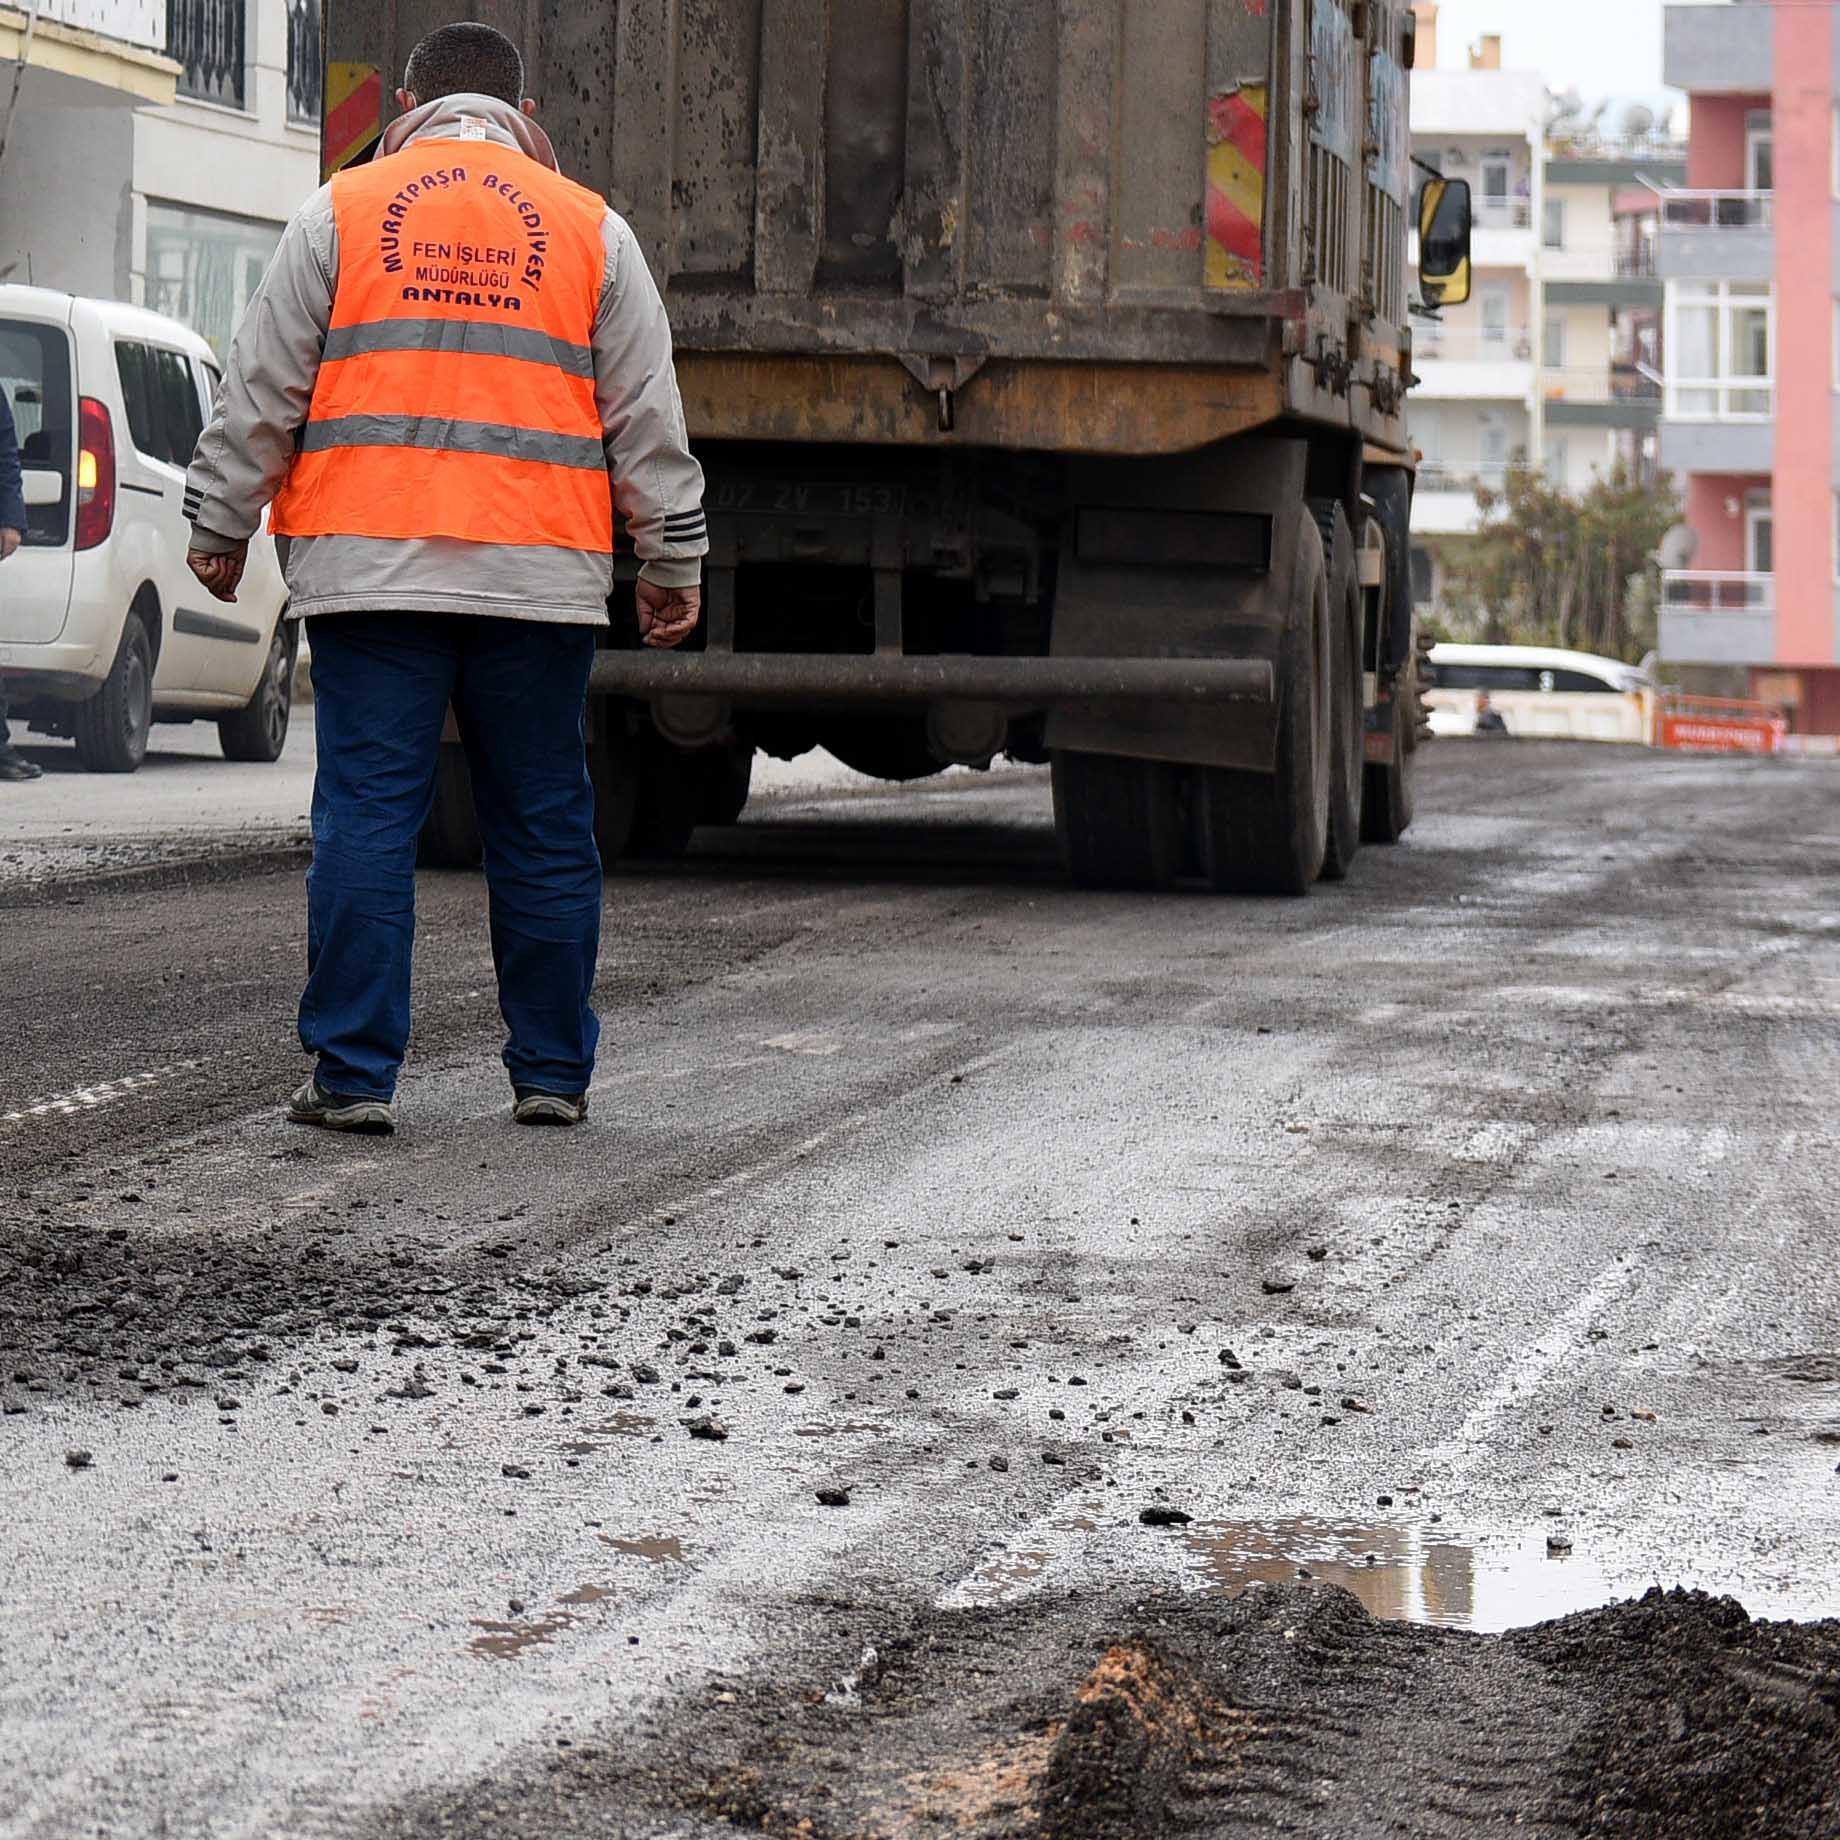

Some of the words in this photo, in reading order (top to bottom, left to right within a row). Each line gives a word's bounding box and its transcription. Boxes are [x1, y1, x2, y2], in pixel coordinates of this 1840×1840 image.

[380, 167, 466, 273] MURATPAŞA
[482, 174, 550, 292] BELEDİYESİ
[412, 242, 452, 260] FEN
[456, 241, 516, 266] İŞLERİ
[415, 264, 510, 289] MÜDÜRLÜĞÜ
[402, 286, 521, 310] ANTALYA
